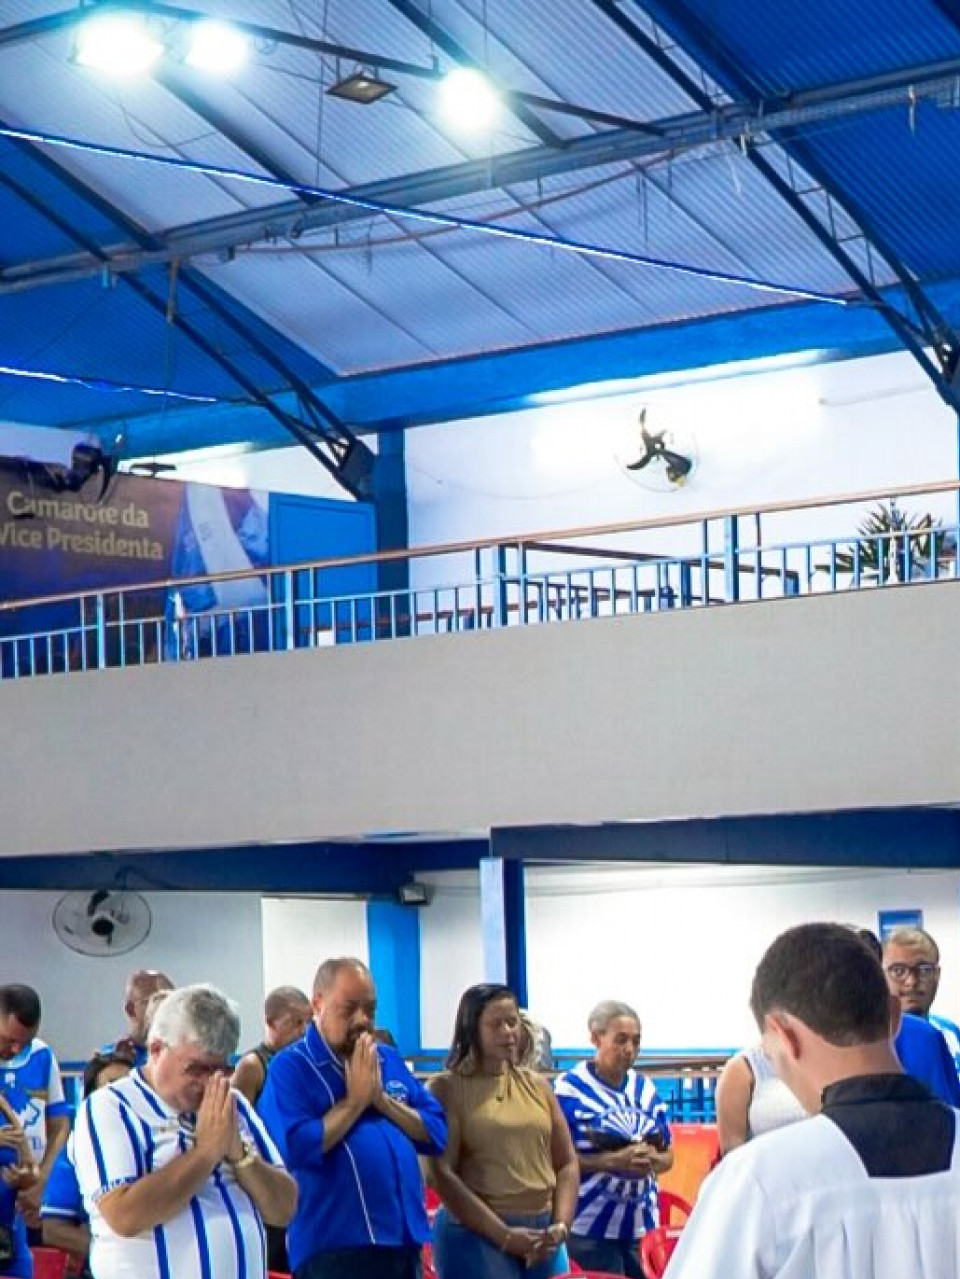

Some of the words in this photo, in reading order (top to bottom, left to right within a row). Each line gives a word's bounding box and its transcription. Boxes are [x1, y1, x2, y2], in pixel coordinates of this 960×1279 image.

[123, 504, 149, 527] da
[0, 524, 42, 547] Vice
[48, 530, 162, 560] Presidenta
